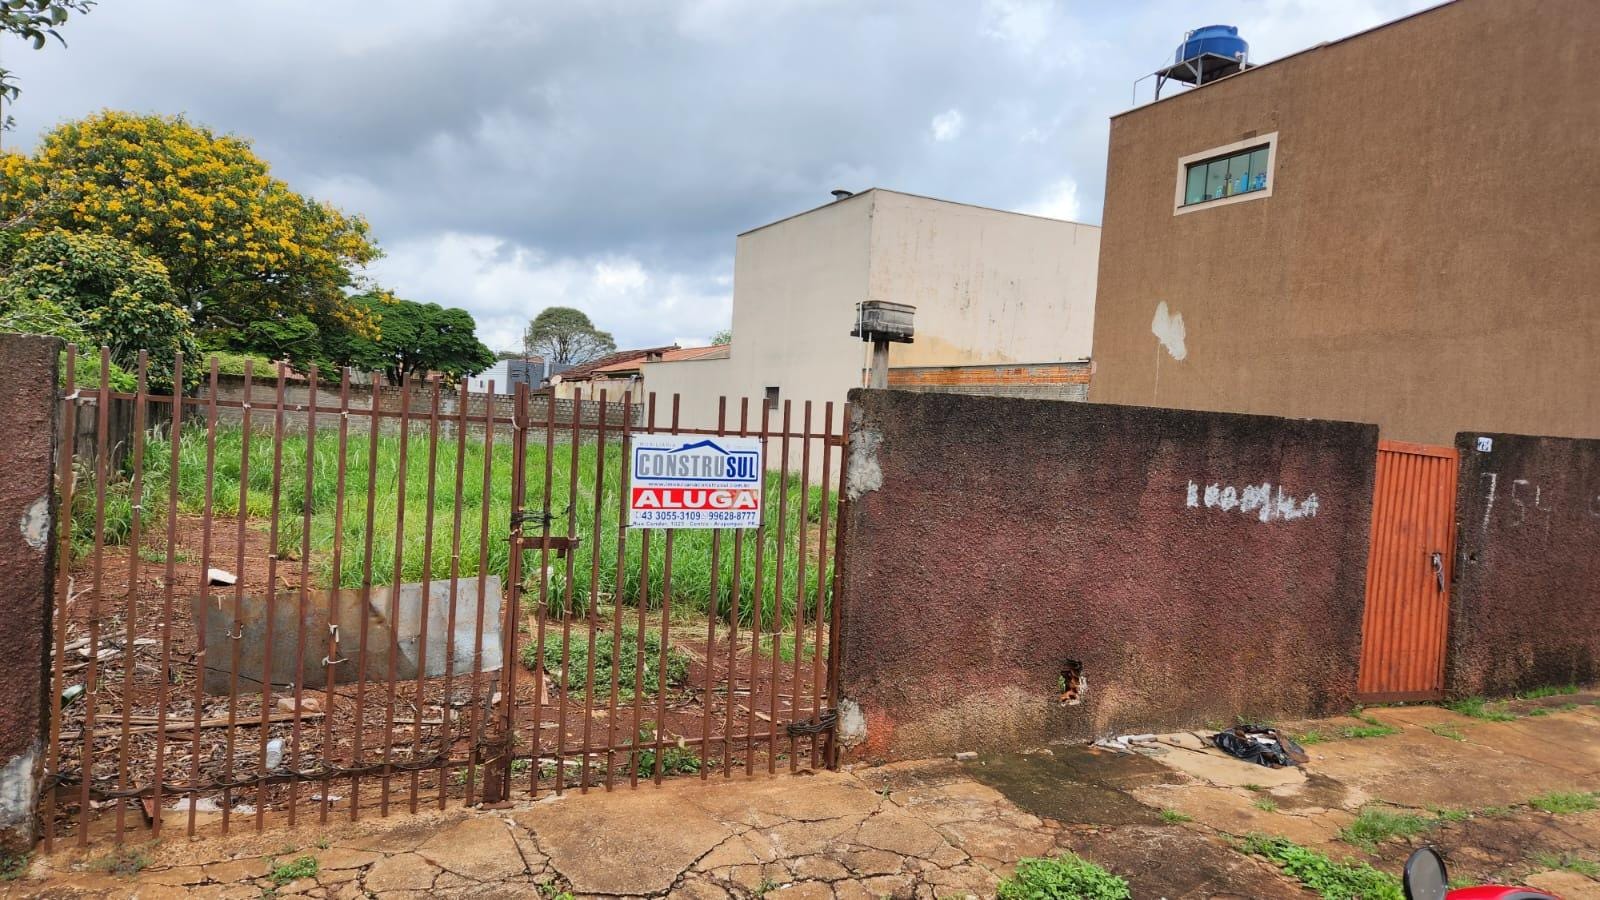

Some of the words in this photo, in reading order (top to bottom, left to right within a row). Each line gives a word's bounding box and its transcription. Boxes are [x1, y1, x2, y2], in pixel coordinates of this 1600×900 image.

[638, 453, 756, 478] CONSTRUSUL
[634, 490, 756, 508] ALUGA
[641, 511, 653, 521] 43
[655, 511, 701, 521] 3055-3109
[708, 511, 756, 521] 99628-8777
